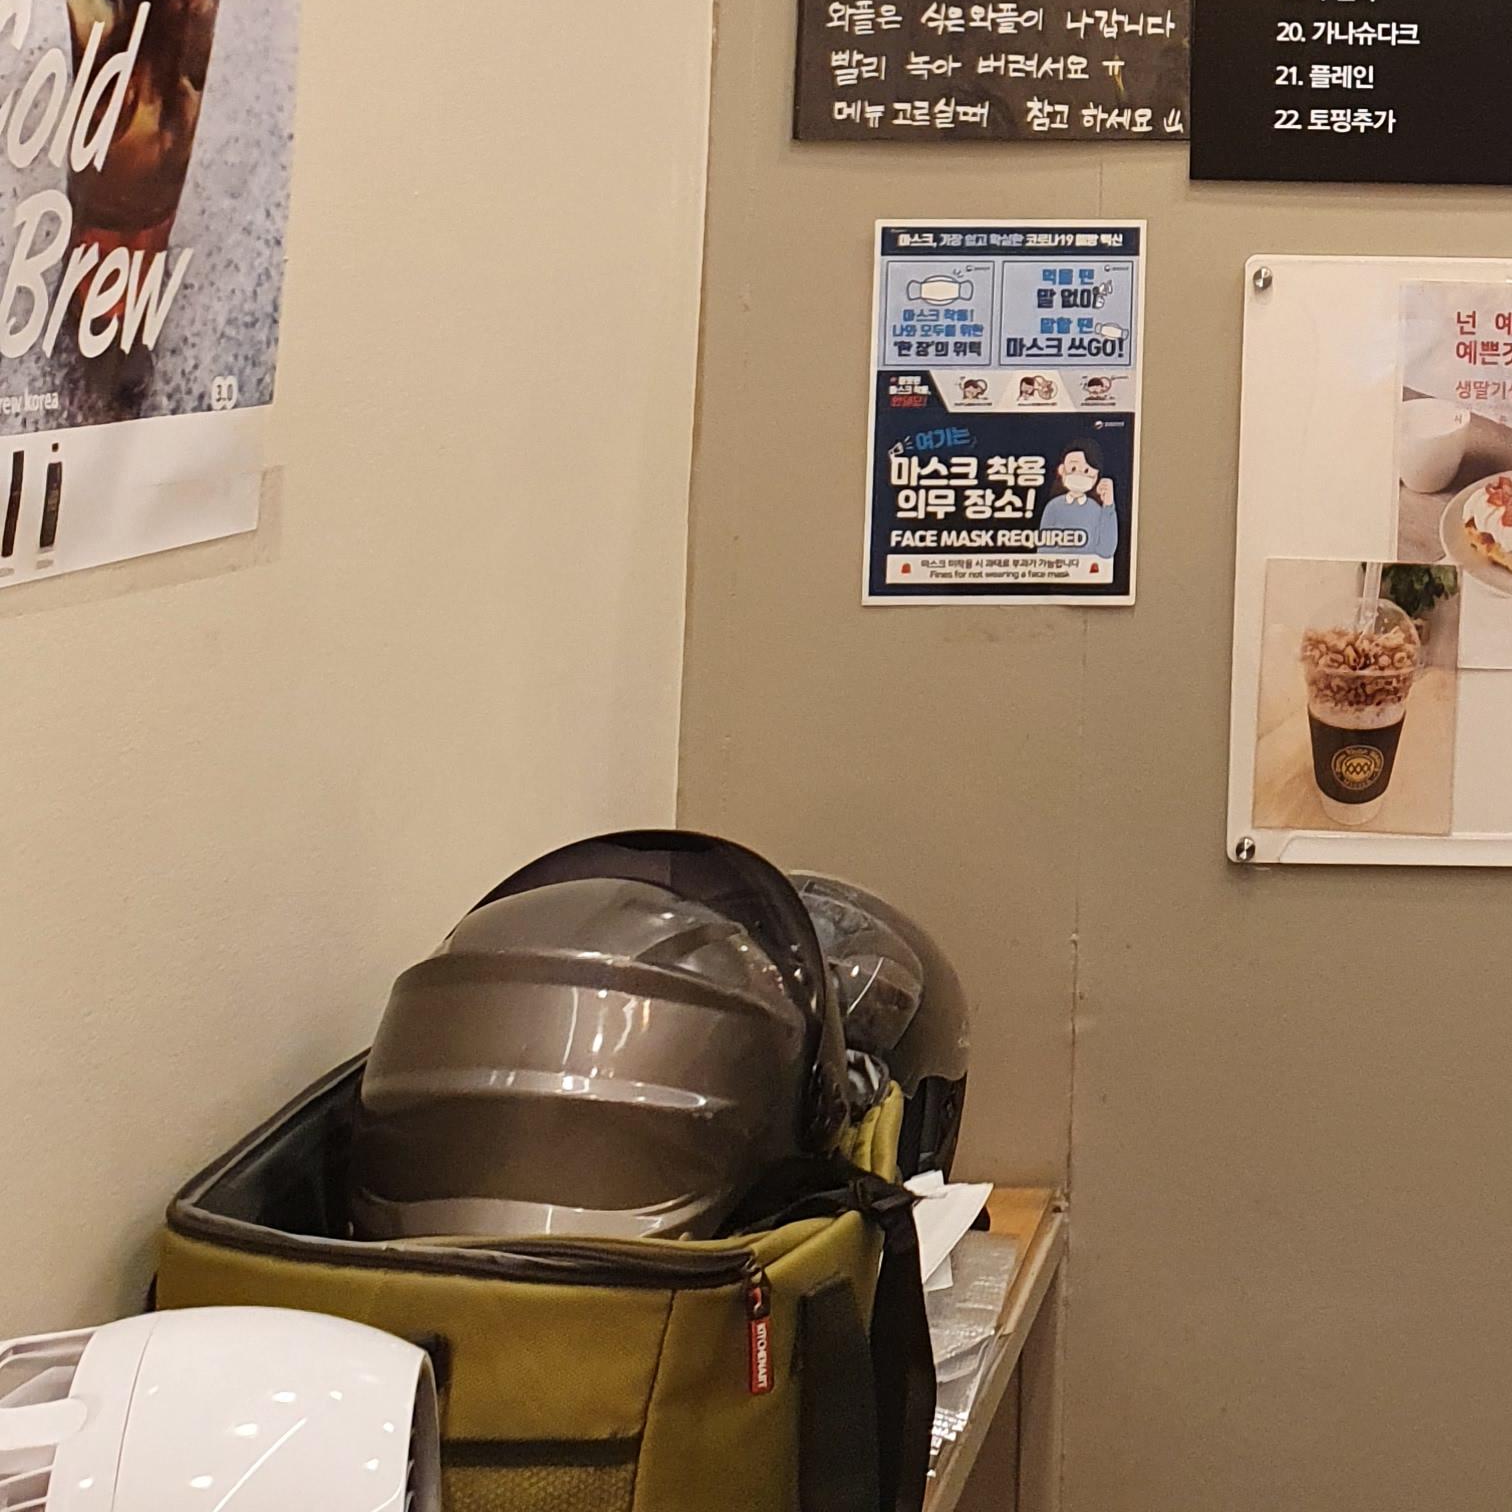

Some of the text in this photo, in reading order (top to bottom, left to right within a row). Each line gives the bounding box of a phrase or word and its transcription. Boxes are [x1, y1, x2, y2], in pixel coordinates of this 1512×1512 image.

[825, 0, 1175, 39] 와플은 나갑니다
[1311, 20, 1421, 46] 가나슈다크
[831, 49, 1089, 86] 빨리 녹아 버려서요
[1309, 64, 1374, 89] 플레인
[833, 96, 1153, 133] 메뉴 참고 하세요
[1307, 108, 1397, 134] 토핑추가
[0, 189, 194, 360] Brew
[1456, 311, 1478, 337] 넌
[1006, 337, 1064, 357] 마스크
[890, 455, 1046, 486] 마스크 착용
[896, 489, 1036, 519] 의무 장소!
[890, 529, 1087, 548] FACE MASK REQUIRED
[954, 570, 966, 578] for
[968, 570, 983, 579] not
